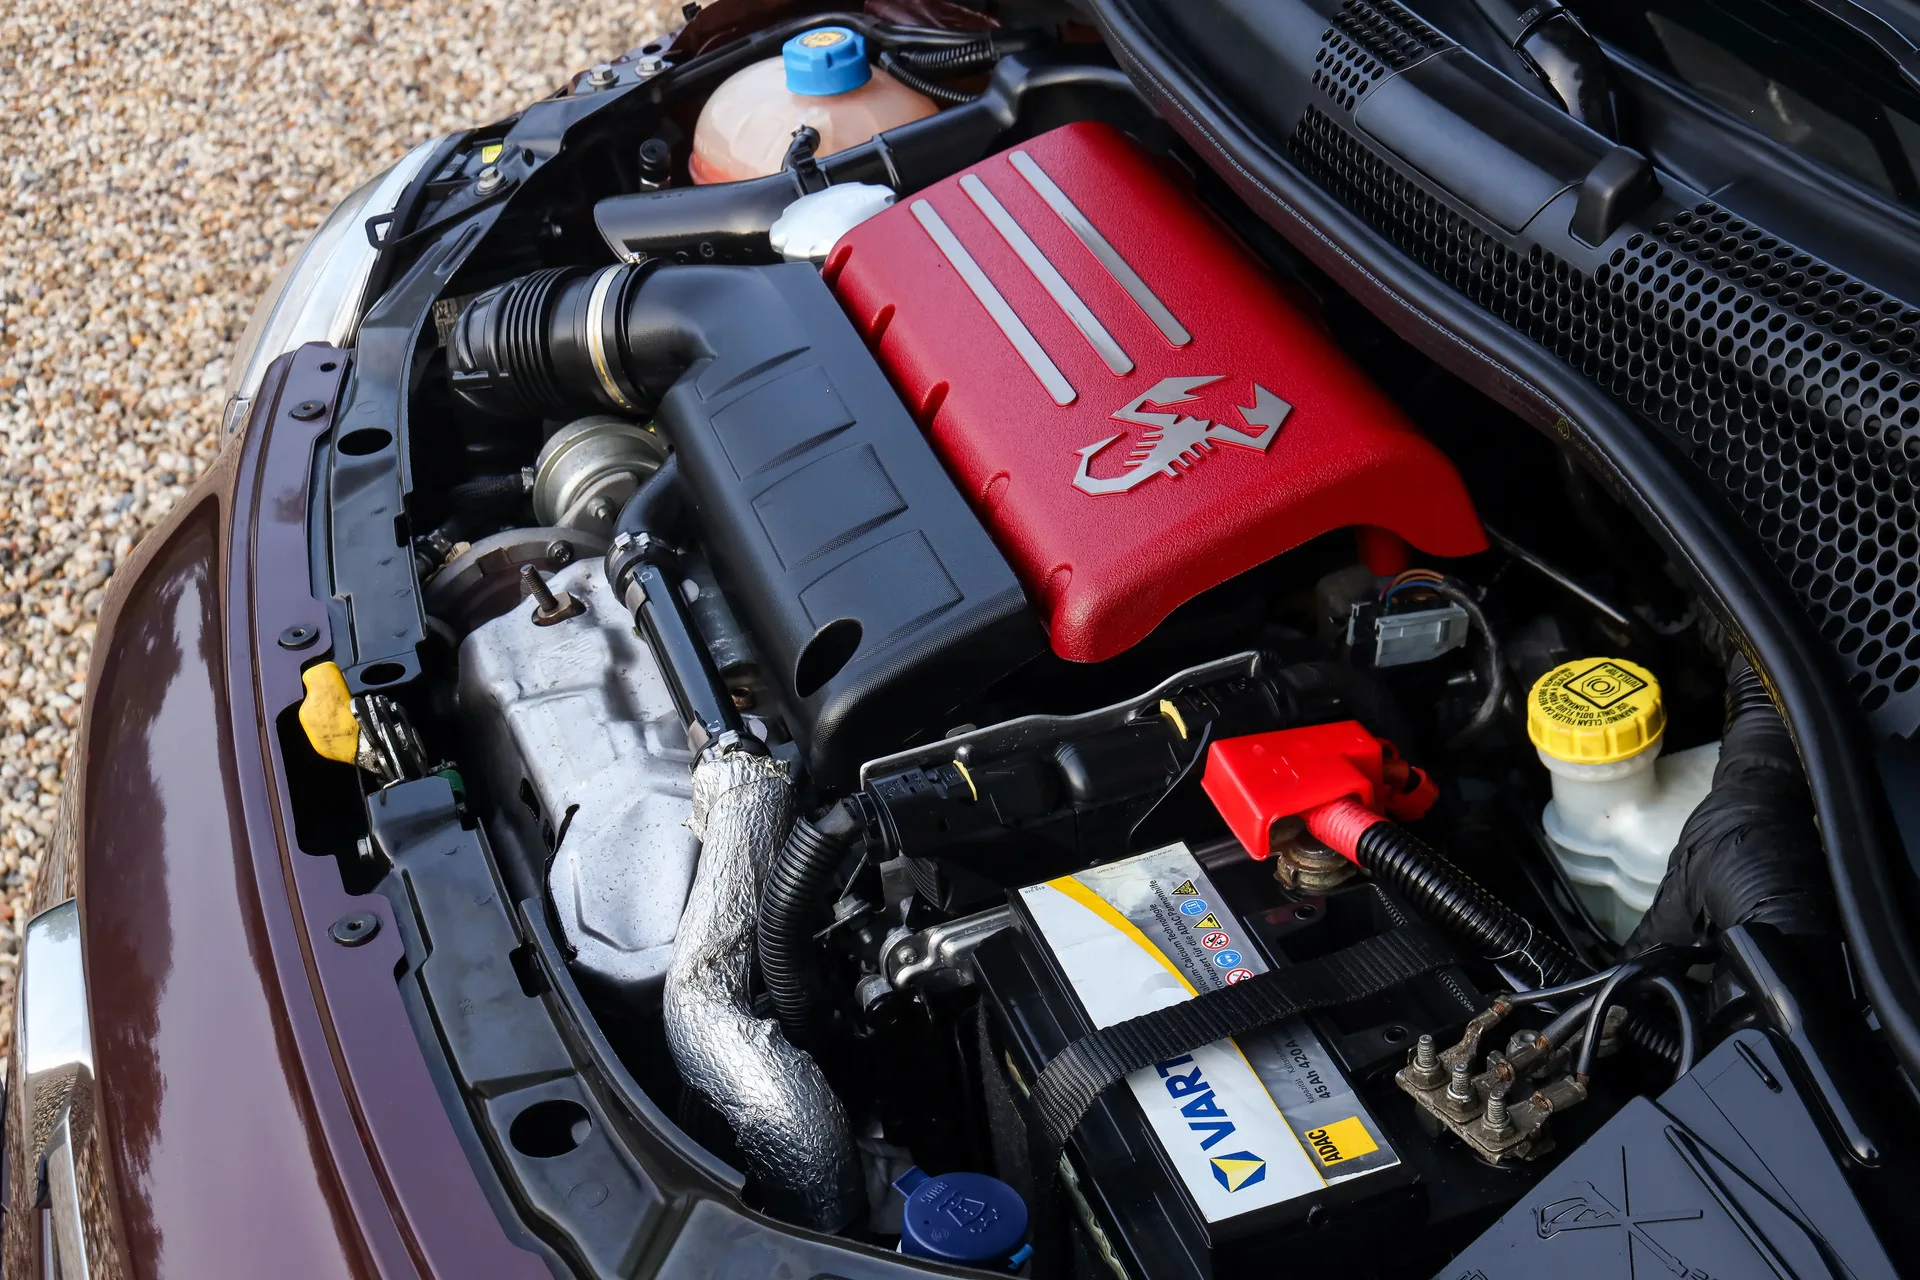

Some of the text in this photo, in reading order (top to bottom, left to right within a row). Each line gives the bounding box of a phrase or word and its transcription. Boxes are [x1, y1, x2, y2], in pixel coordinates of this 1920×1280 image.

[1605, 668, 1618, 677] TOP
[1618, 673, 1641, 688] TUTELA
[1548, 692, 1560, 706] FROM
[1560, 693, 1590, 712] CONTAINER
[1616, 702, 1630, 711] USE
[1542, 706, 1554, 716] CAP
[1556, 705, 1576, 716] FLUID
[1596, 710, 1616, 718] ONLY
[1605, 706, 1640, 724] WARNING!
[1553, 714, 1576, 726] FILLER
[1150, 904, 1176, 942] Technologie
[1149, 880, 1225, 990] roduziert für die ADAC Pannenhilfe
[1295, 1078, 1316, 1104] Kapazität
[1155, 1054, 1236, 1152] VART
[1308, 1129, 1343, 1162] ADAC
